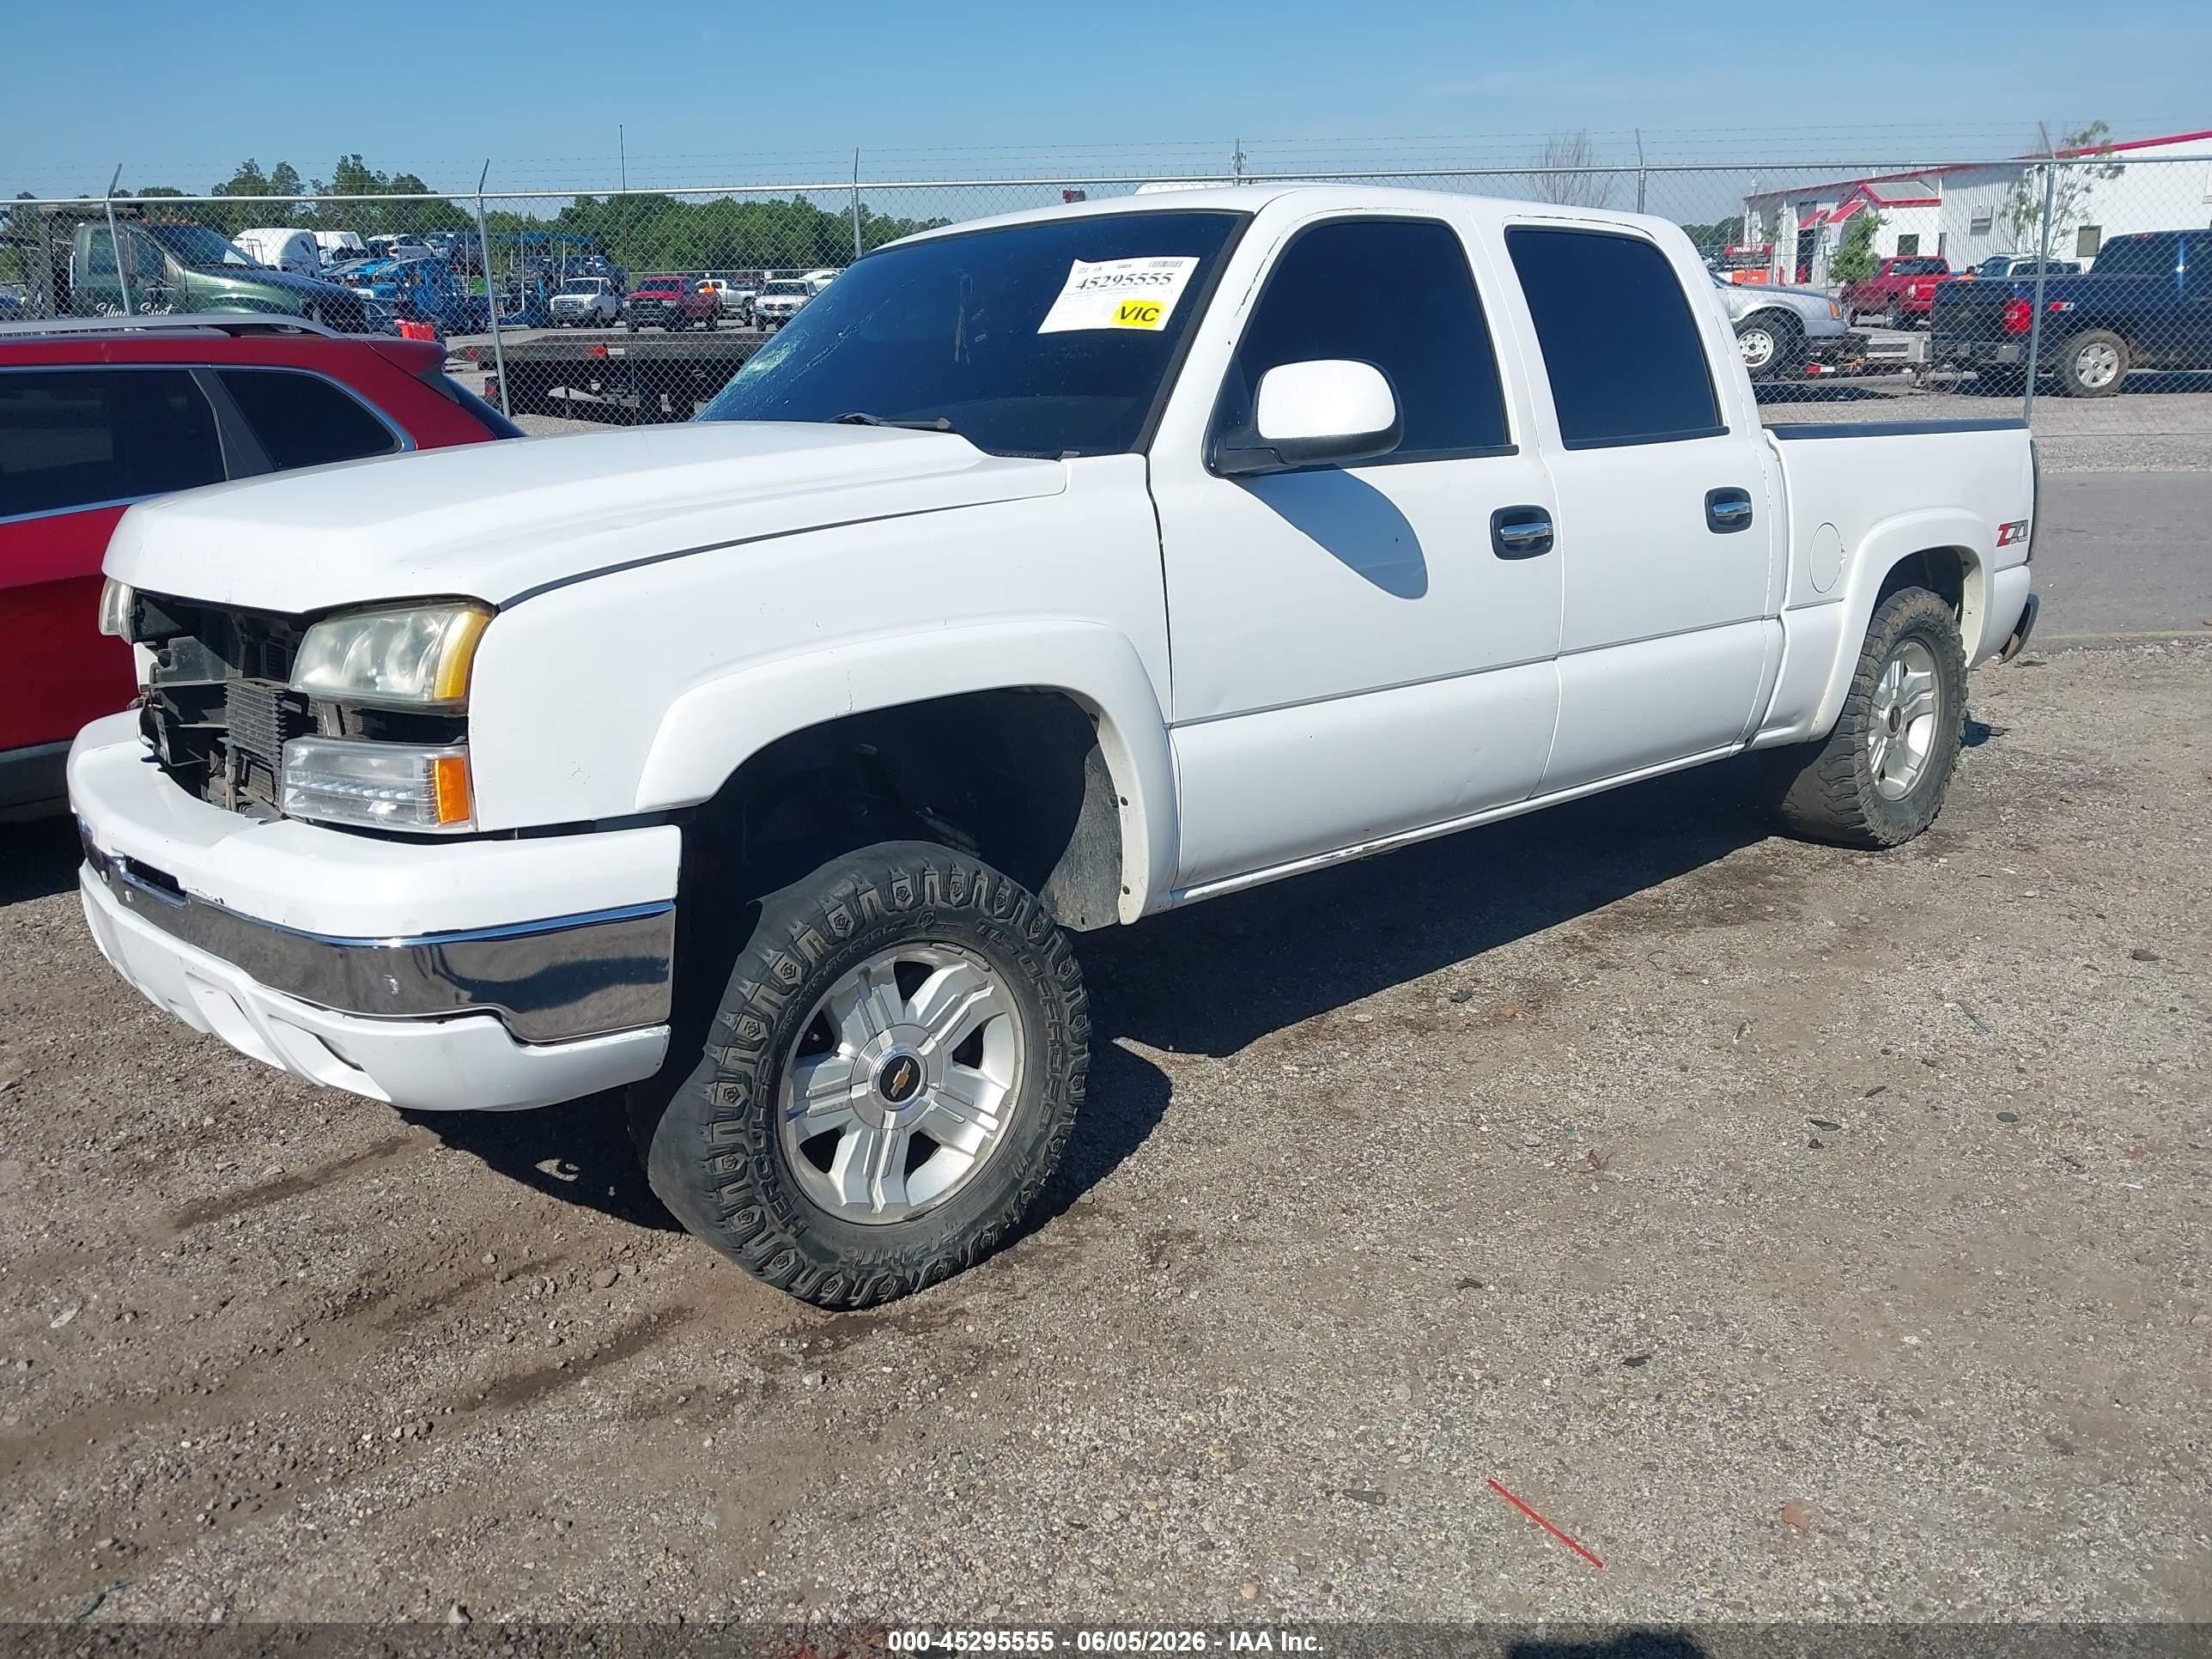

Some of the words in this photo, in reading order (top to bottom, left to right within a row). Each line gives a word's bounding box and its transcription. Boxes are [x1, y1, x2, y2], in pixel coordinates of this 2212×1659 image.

[1075, 272, 1176, 290] 45295555
[1120, 306, 1160, 322] VIC
[1996, 520, 2029, 547] Z71
[754, 1057, 811, 1239] HERCULES
